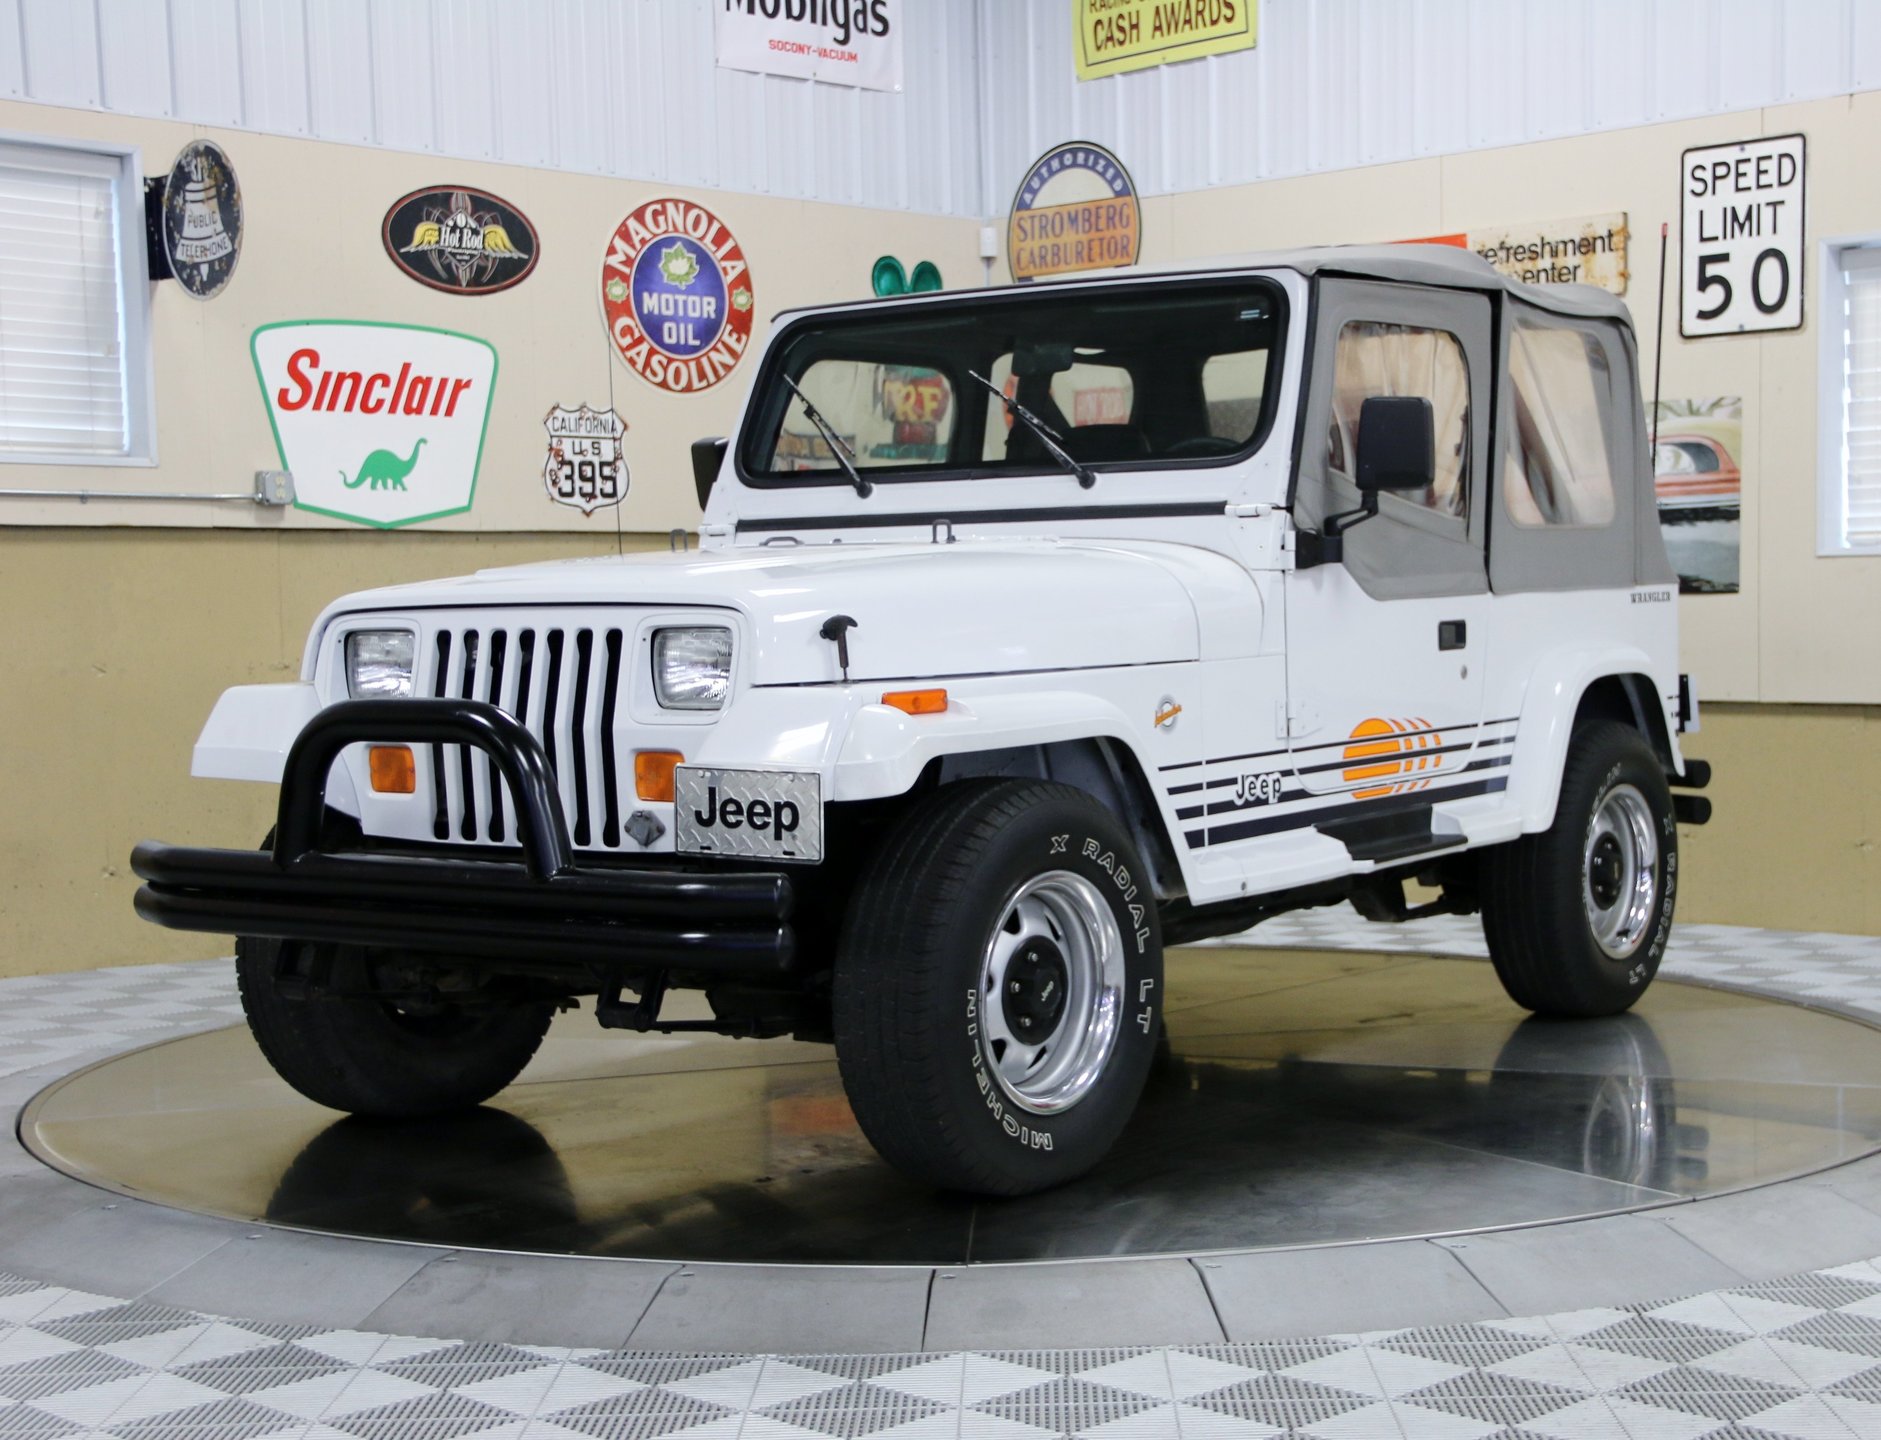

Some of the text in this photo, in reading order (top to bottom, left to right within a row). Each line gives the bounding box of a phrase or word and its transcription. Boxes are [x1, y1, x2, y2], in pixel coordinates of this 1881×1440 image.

[1093, 0, 1237, 52] CASH AWARDS
[768, 39, 859, 63] SOCONY-VACUUM
[1022, 151, 1125, 206] AUTHORIZED
[1690, 152, 1796, 197] SPEED
[187, 211, 218, 229] PUBLIC
[440, 226, 484, 250] Hot Rod
[1016, 202, 1132, 243] STROMBERG
[1699, 200, 1785, 243] LIMIT
[180, 235, 229, 260] TELEPHONE
[605, 200, 747, 284] MAGNOLIA
[1016, 234, 1131, 271] CARBURETOR
[1519, 263, 1582, 284] enter
[1696, 247, 1790, 320] 50
[642, 291, 717, 319] MOTOR
[613, 315, 748, 391] GASOLINE
[662, 321, 701, 346] OIL
[277, 348, 473, 418] Sinclair
[552, 416, 618, 435] CALIFORNIA
[558, 460, 618, 498] 395
[1630, 591, 1671, 603] WRANGLER
[1235, 773, 1281, 801] Jeep
[694, 786, 800, 842] Jeep
[1050, 835, 1154, 1034] X RADIAL LT
[967, 989, 1054, 1151] MICHELIN
